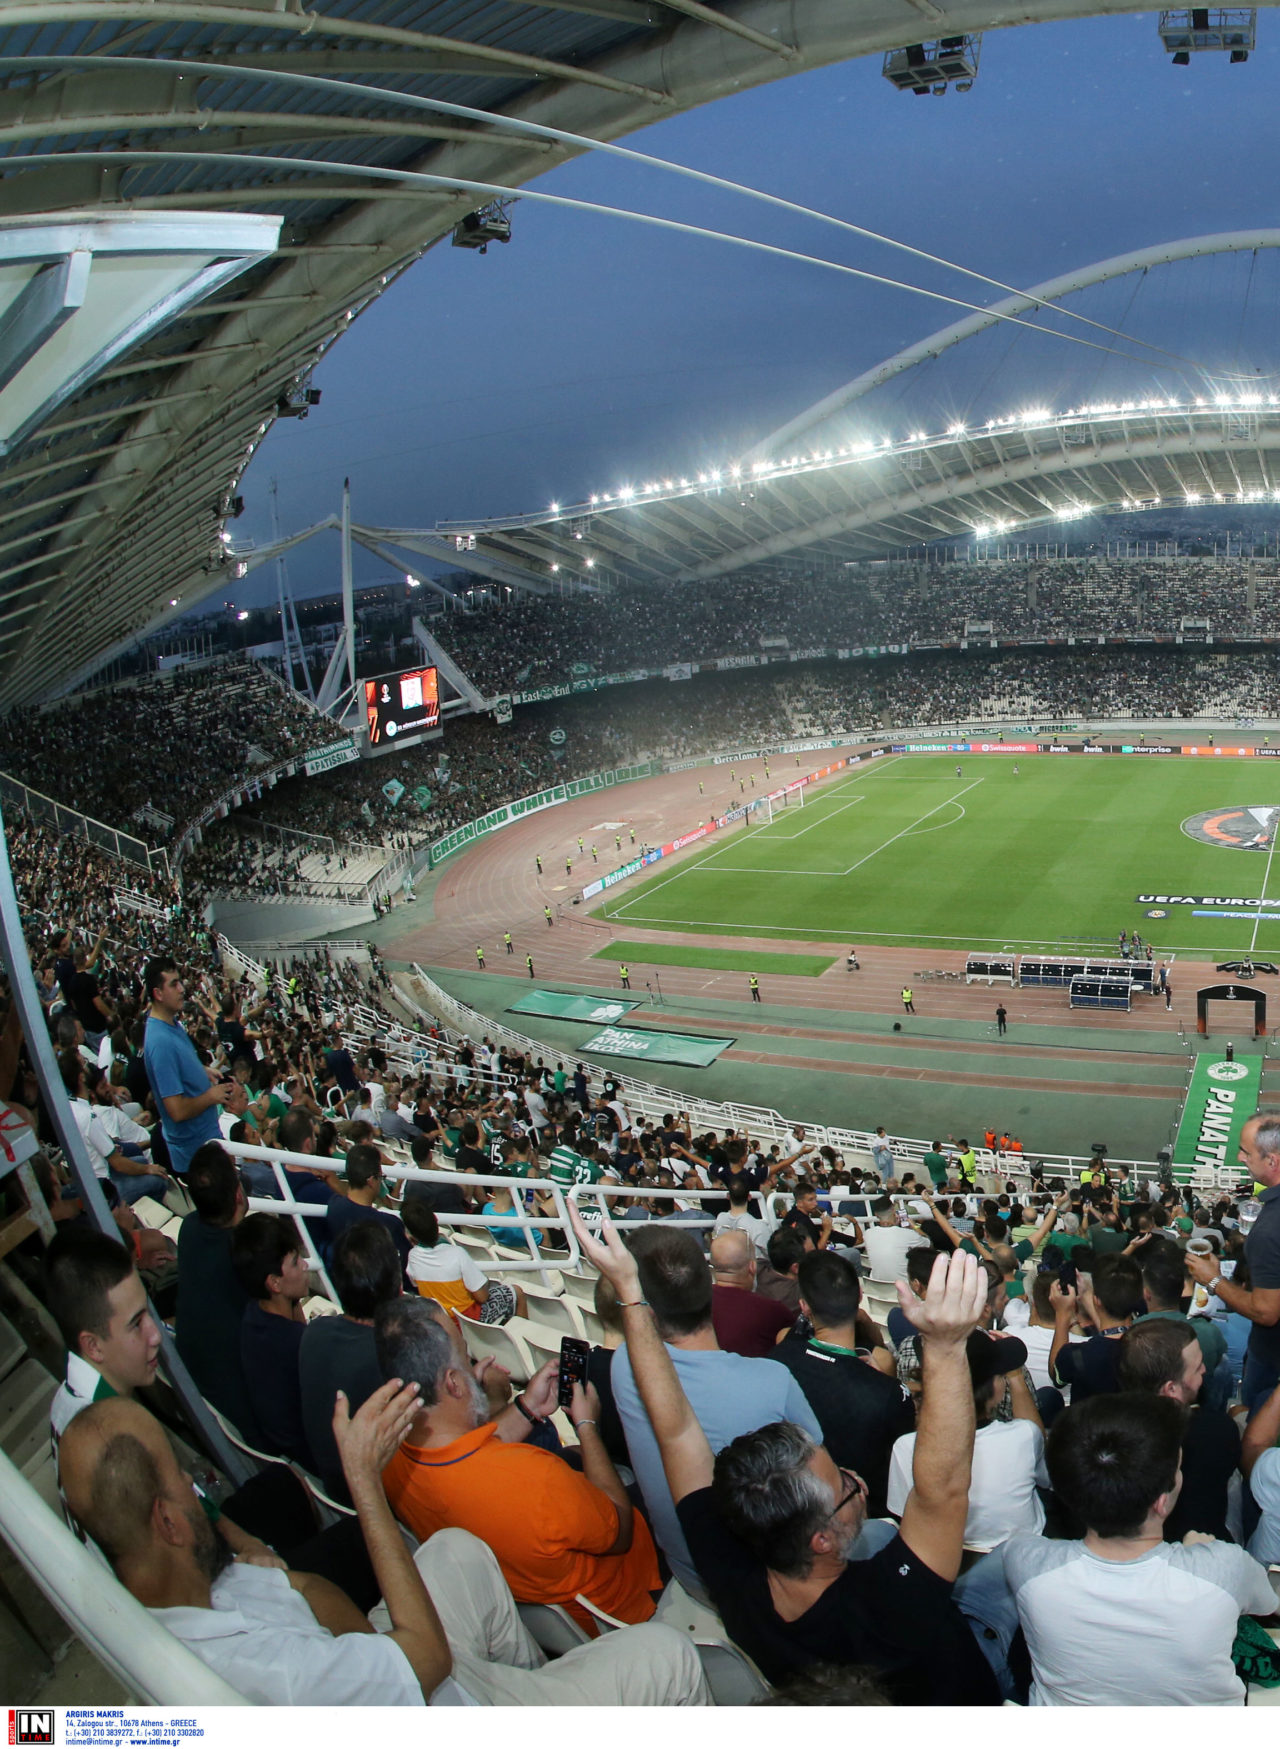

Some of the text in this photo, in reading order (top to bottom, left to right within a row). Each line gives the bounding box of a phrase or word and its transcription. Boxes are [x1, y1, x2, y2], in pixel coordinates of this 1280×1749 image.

[522, 683, 570, 703] East End
[989, 744, 1026, 752] Swissquote
[432, 822, 475, 860] GREEN
[477, 808, 508, 834] AND
[511, 785, 566, 817] WHITE
[567, 774, 603, 796] TILL
[605, 862, 642, 887] Heineken
[1138, 895, 1197, 904] UEFA
[602, 1028, 635, 1040] PAN
[583, 1043, 625, 1054] IKOS
[592, 1036, 650, 1051] ATHINA
[490, 1143, 503, 1165] 15
[575, 1165, 591, 1185] 22
